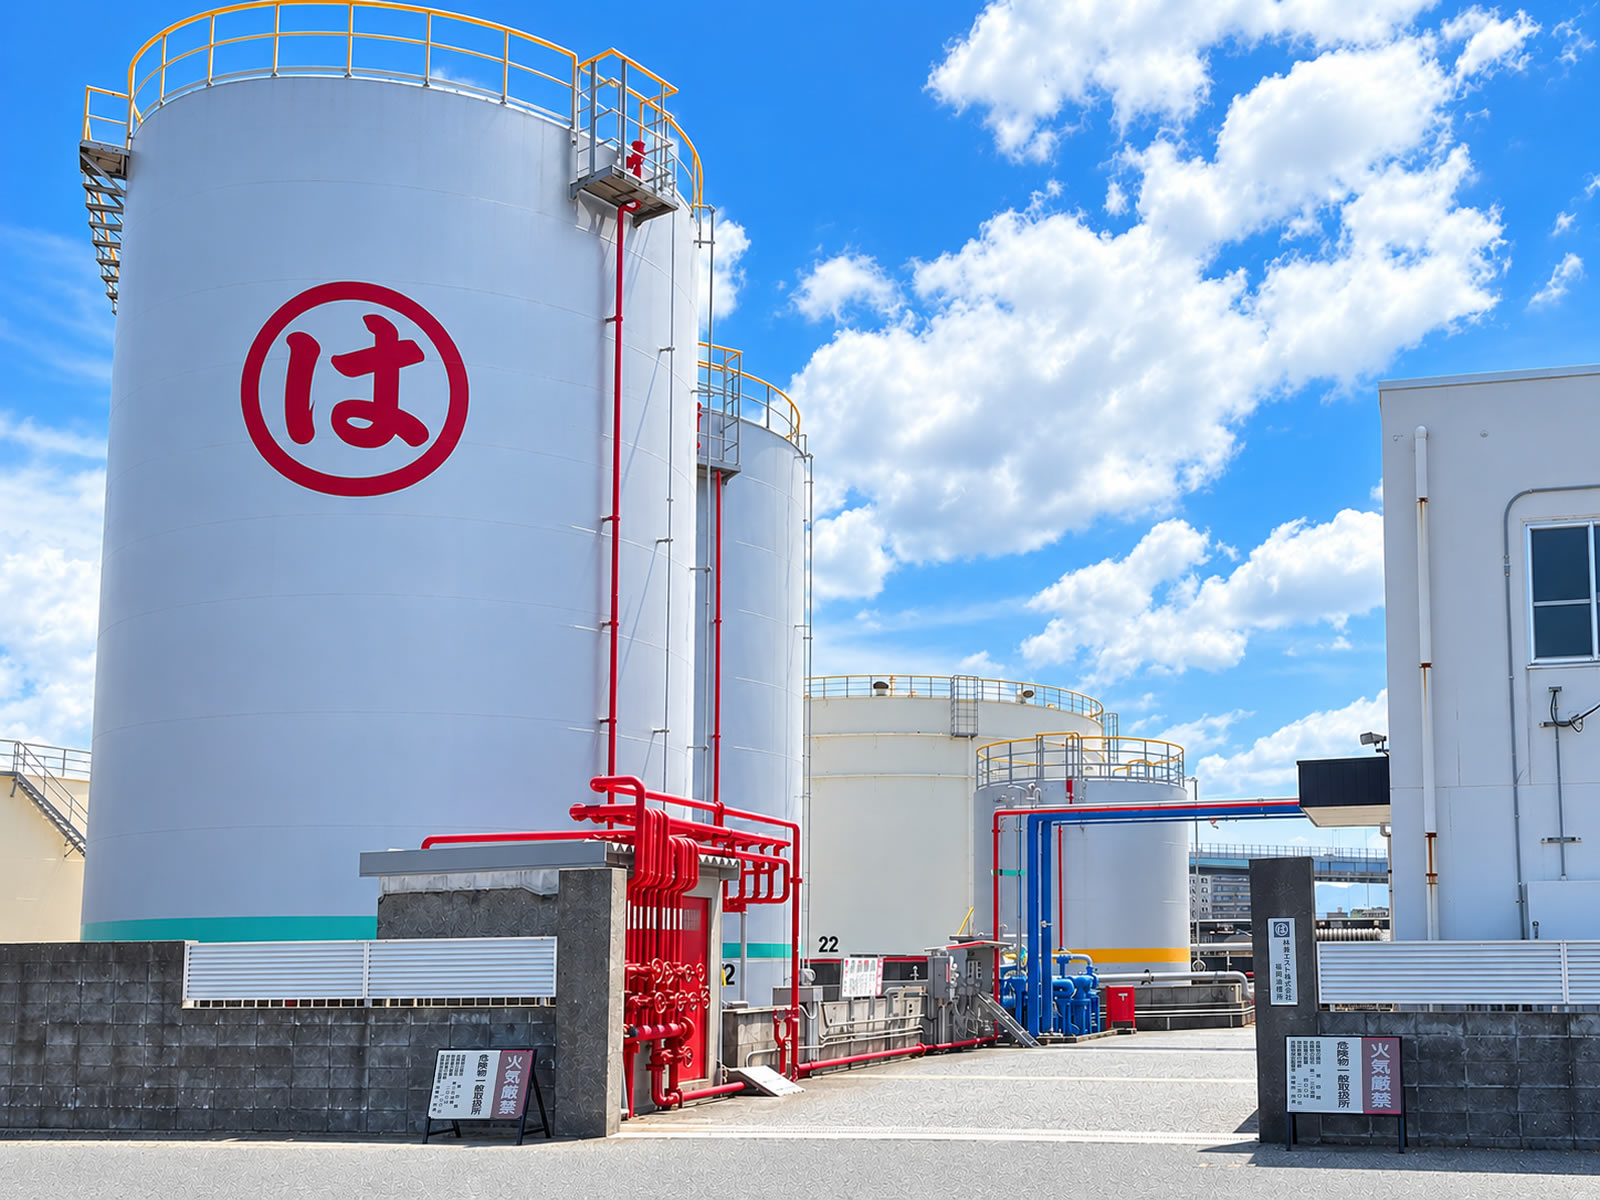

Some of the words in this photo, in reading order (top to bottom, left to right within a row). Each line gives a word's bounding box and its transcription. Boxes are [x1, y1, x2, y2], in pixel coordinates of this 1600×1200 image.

[285, 314, 430, 449] は
[818, 935, 839, 953] 22
[470, 1053, 490, 1116] 危険物一般取扱所
[498, 1054, 523, 1115] 火気厳禁
[1336, 1041, 1351, 1108] 危険物一般取扱所
[1370, 1042, 1392, 1108] 火気厳禁
